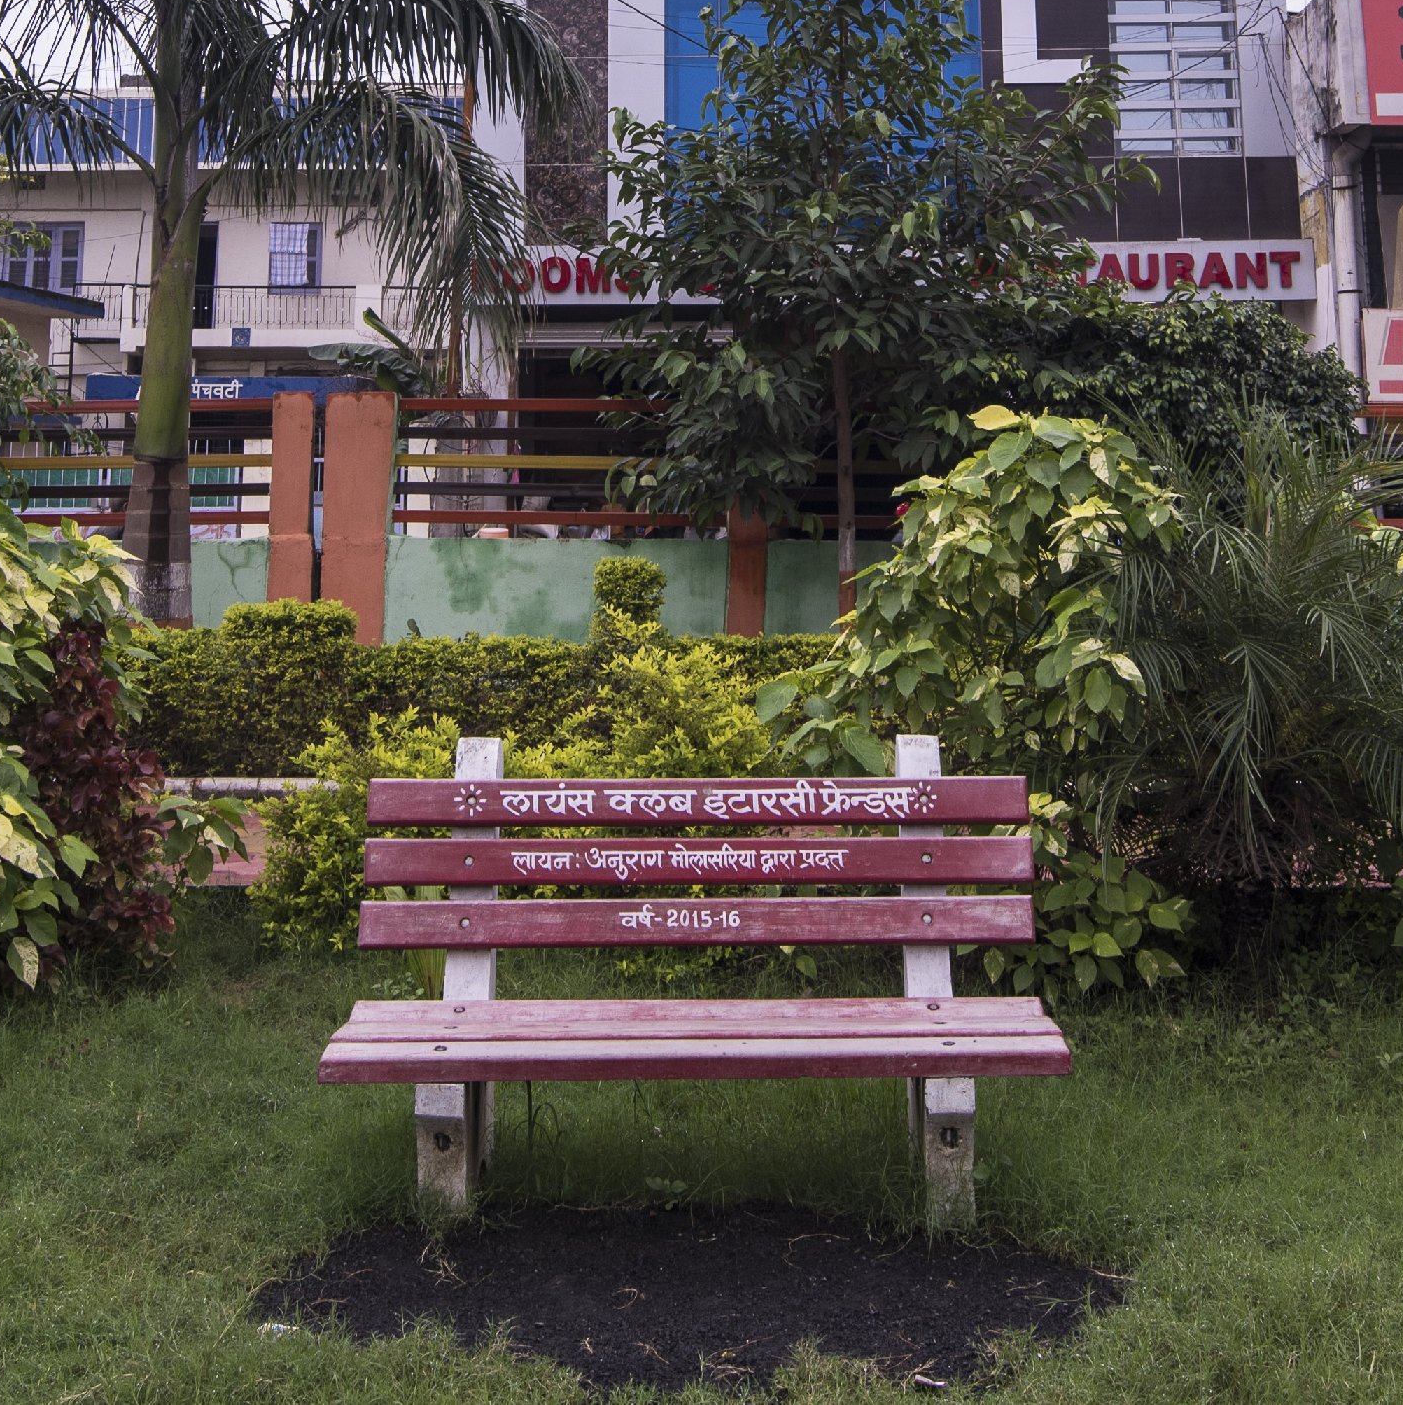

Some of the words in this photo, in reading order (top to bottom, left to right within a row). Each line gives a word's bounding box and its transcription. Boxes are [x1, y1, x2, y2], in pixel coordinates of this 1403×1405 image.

[500, 782, 596, 816] लायंस
[603, 789, 698, 818] क्लब
[702, 780, 817, 819] इटारसी
[584, 847, 665, 880] अनुराग
[666, 909, 741, 928] 2015-16
